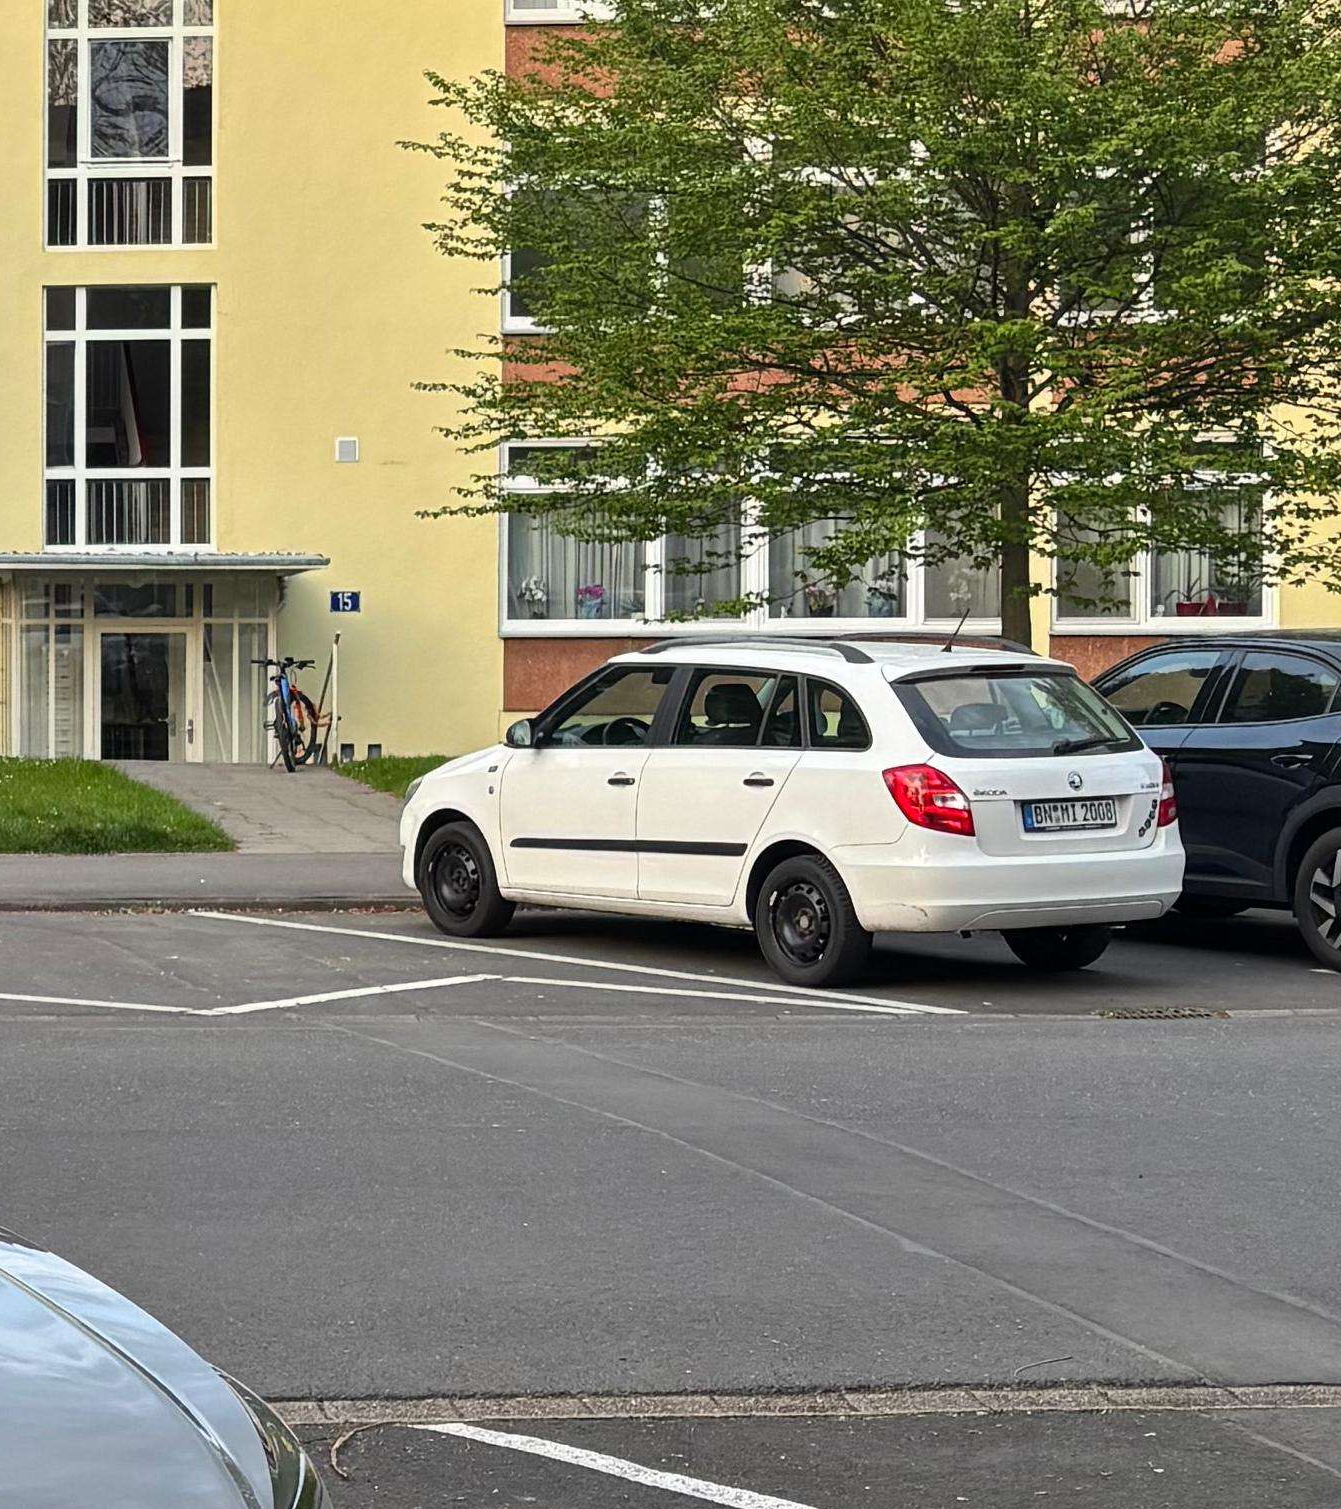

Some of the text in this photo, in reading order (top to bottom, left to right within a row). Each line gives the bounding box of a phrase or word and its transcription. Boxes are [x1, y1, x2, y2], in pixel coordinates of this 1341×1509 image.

[337, 592, 352, 611] 15
[1034, 801, 1113, 824] BN MI 2008
